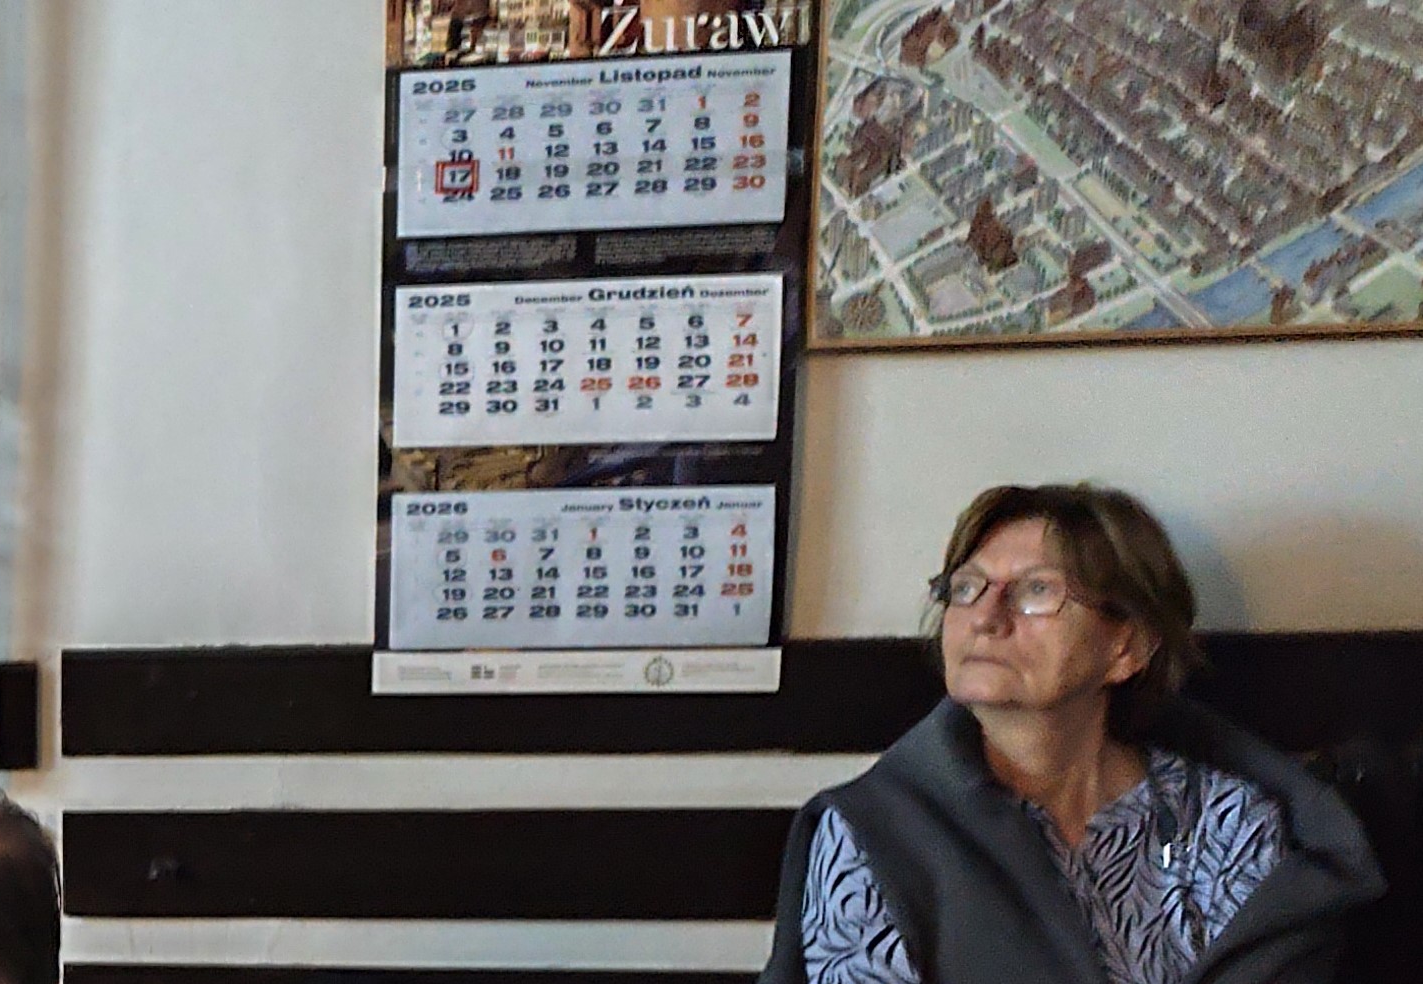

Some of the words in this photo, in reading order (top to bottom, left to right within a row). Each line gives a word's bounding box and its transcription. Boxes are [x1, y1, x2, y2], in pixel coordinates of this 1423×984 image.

[600, 65, 702, 84] Listopad
[413, 79, 476, 95] 2025
[697, 96, 706, 109] 1
[743, 94, 760, 108] 2
[452, 129, 468, 143] 3
[500, 127, 515, 140] 4
[548, 124, 564, 138] 5
[596, 122, 612, 136] 6
[646, 118, 661, 134] 7
[694, 116, 710, 130] 8
[743, 112, 759, 128] 9
[499, 147, 515, 161] 11
[545, 144, 569, 158] 12
[594, 141, 618, 156] 13
[642, 139, 666, 153] 14
[692, 136, 716, 151] 15
[741, 134, 764, 148] 16
[449, 170, 471, 183] 17
[497, 166, 521, 181] 18
[545, 164, 569, 178] 19
[586, 162, 619, 175] 20
[637, 158, 662, 174] 21
[684, 156, 717, 171] 22
[733, 153, 766, 169] 23
[490, 185, 522, 201] 25
[538, 184, 570, 199] 26
[586, 180, 619, 197] 27
[635, 178, 668, 194] 28
[684, 175, 717, 192] 29
[733, 175, 765, 190] 30
[408, 294, 470, 308] 2025
[588, 285, 694, 301] Grudzień
[450, 323, 459, 336] 1
[495, 321, 511, 334] 2
[543, 318, 558, 334] 3
[591, 317, 606, 331] 4
[639, 314, 655, 330] 5
[688, 313, 704, 329] 6
[737, 312, 752, 327] 7
[448, 343, 463, 356] 8
[495, 341, 510, 354] 9
[540, 339, 565, 353] 10
[590, 338, 606, 351] 11
[636, 336, 661, 350] 12
[685, 333, 709, 349] 13
[733, 333, 758, 347] 14
[446, 361, 469, 376] 15
[492, 360, 516, 375] 16
[540, 359, 564, 373] 17
[588, 357, 611, 371] 18
[636, 356, 660, 370] 19
[678, 355, 711, 369] 20
[728, 353, 753, 368] 21
[439, 381, 471, 396] 22
[486, 380, 518, 394] 23
[533, 378, 565, 393] 24
[580, 377, 612, 392] 25
[628, 376, 661, 390] 26
[678, 375, 710, 389] 27
[726, 373, 759, 387] 28
[439, 401, 470, 415] 29
[486, 400, 518, 414] 30
[535, 398, 558, 412] 31
[592, 396, 600, 410] 1
[636, 394, 653, 409] 2
[685, 394, 701, 407] 3
[733, 393, 751, 406] 4
[407, 502, 468, 516] 2026
[619, 496, 710, 513] Styczeń
[589, 527, 598, 541] 1
[634, 525, 650, 541] 2
[683, 525, 699, 539] 3
[731, 523, 747, 537] 4
[446, 549, 460, 563] 5
[491, 548, 506, 562] 6
[539, 547, 554, 561] 7
[586, 547, 602, 560] 8
[634, 546, 650, 560] 9
[680, 545, 705, 559] 10
[731, 544, 747, 557] 11
[443, 568, 466, 583] 12
[489, 568, 513, 581] 13
[536, 566, 560, 580] 14
[584, 566, 608, 580] 15
[632, 566, 655, 579] 16
[680, 565, 704, 578] 17
[728, 564, 752, 576] 18
[443, 588, 466, 601] 19
[483, 587, 515, 601] 20
[531, 586, 555, 600] 21
[577, 585, 609, 598] 22
[625, 585, 657, 599] 23
[673, 584, 705, 598] 24
[721, 583, 753, 596] 25
[437, 607, 468, 620] 26
[483, 606, 514, 619] 27
[529, 605, 560, 619] 28
[576, 603, 608, 618] 29
[625, 603, 656, 618] 30
[674, 603, 698, 617] 31
[733, 603, 740, 616] 1
